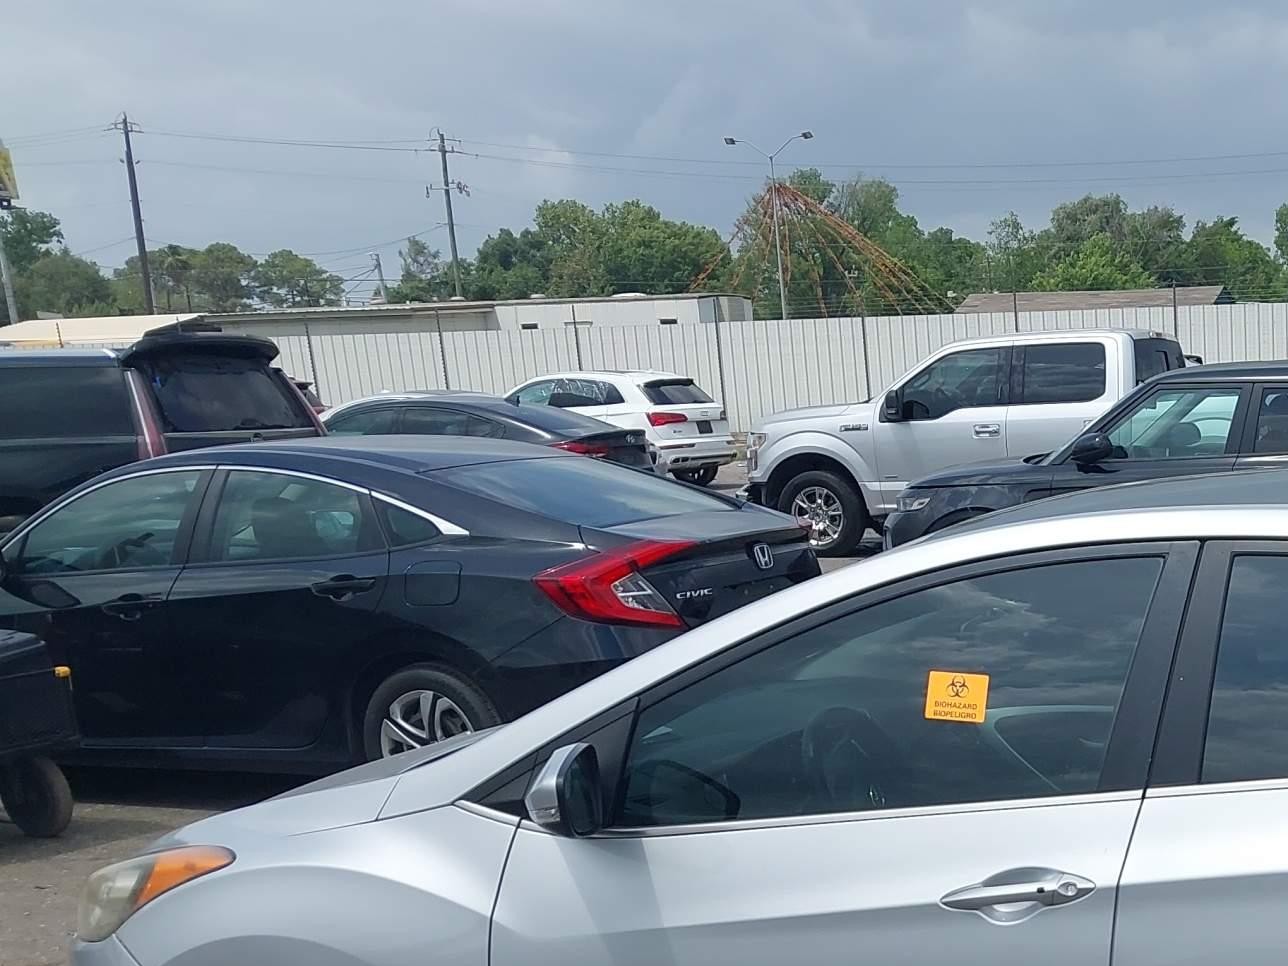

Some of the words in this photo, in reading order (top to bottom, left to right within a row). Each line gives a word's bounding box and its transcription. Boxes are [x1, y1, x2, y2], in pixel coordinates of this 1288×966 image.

[676, 588, 712, 599] CIVIC
[934, 700, 978, 711] BIOHAZARD
[933, 709, 977, 720] BIOPELIGRO
